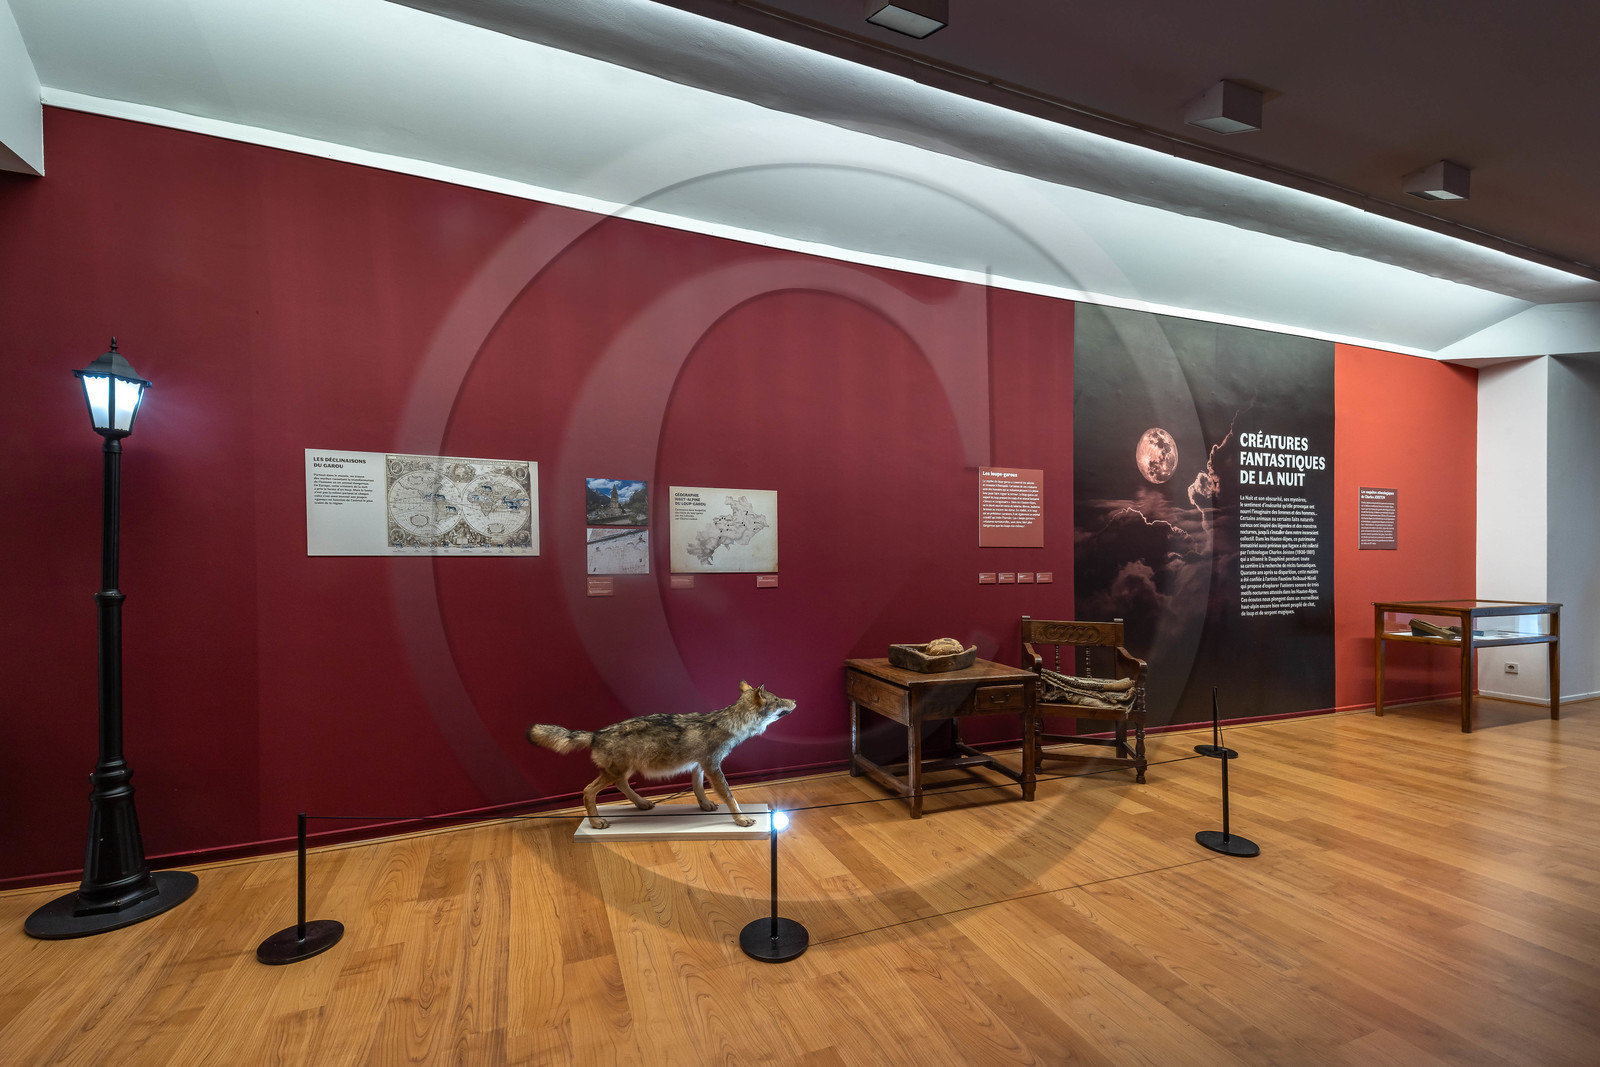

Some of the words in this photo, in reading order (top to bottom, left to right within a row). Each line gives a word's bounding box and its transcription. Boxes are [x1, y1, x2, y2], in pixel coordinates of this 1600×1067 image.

[1240, 430, 1308, 451] CRÉATURES
[1240, 451, 1326, 472] FANTASTIQUES
[1240, 470, 1255, 484] DE
[1259, 471, 1274, 485] LA
[1277, 472, 1305, 486] NUIT
